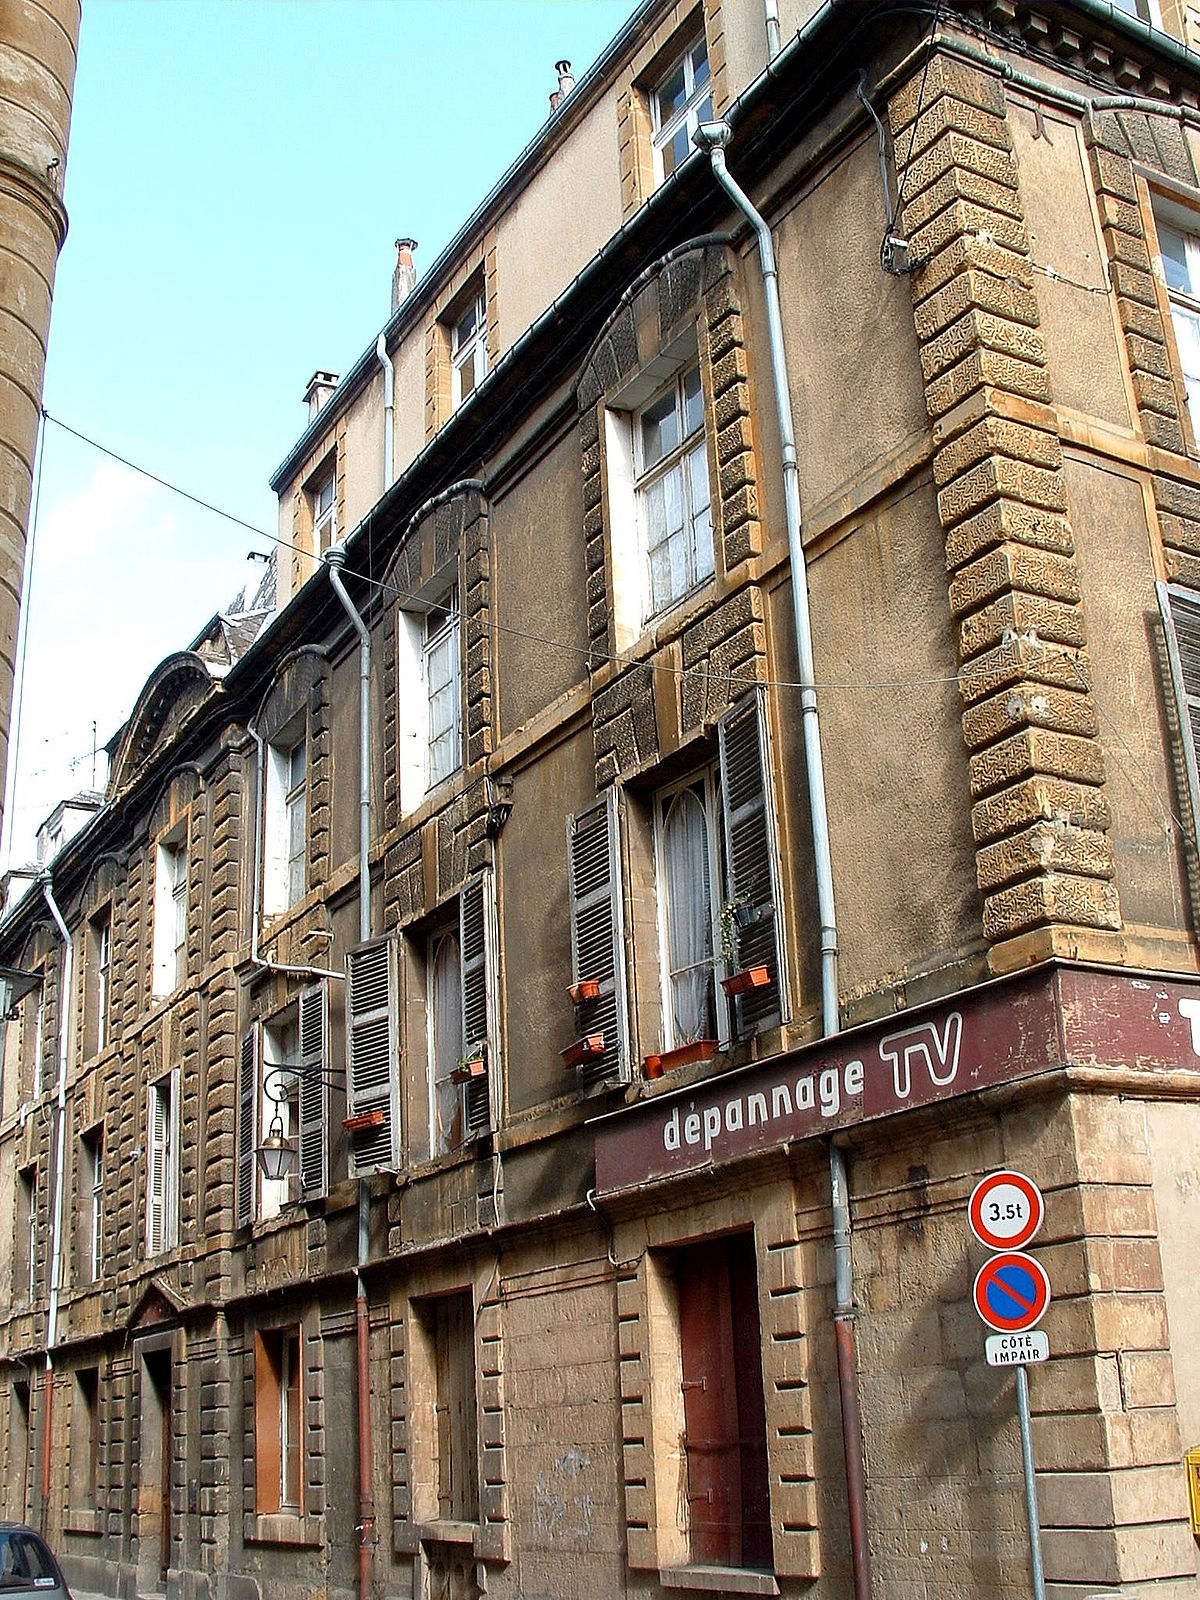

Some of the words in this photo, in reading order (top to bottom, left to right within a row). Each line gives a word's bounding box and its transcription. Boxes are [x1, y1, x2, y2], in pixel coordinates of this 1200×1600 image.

[664, 1059, 864, 1151] dépannage
[879, 1011, 964, 1098] TV
[989, 1203, 1023, 1222] 3.5t
[994, 1349, 1040, 1363] IMPAIR
